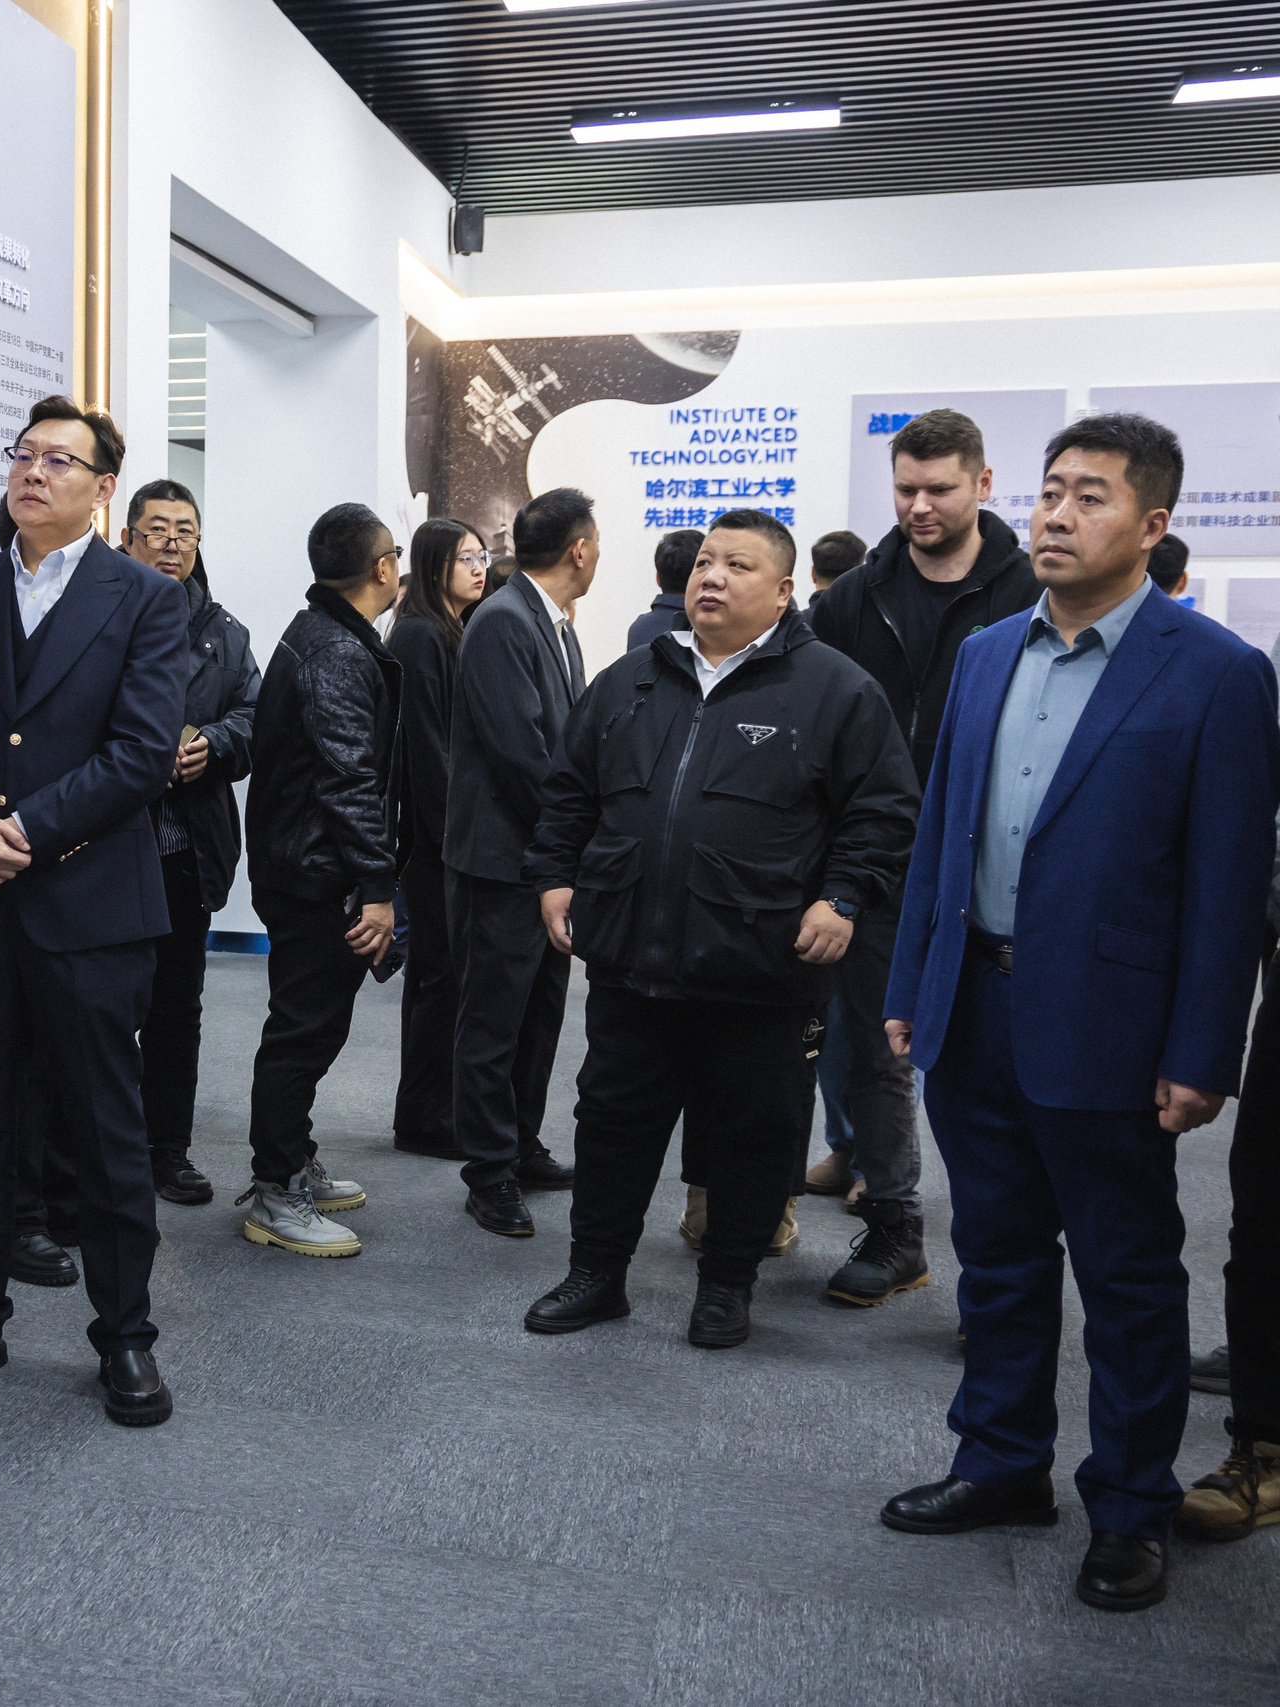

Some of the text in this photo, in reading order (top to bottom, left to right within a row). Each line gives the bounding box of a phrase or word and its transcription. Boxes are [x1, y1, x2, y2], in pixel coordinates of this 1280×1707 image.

[670, 406, 799, 424] INSTITUTE OF
[689, 427, 797, 444] ADVANCED
[646, 477, 796, 499] 哈尔滨工业大学
[644, 507, 795, 528] 先进技术院
